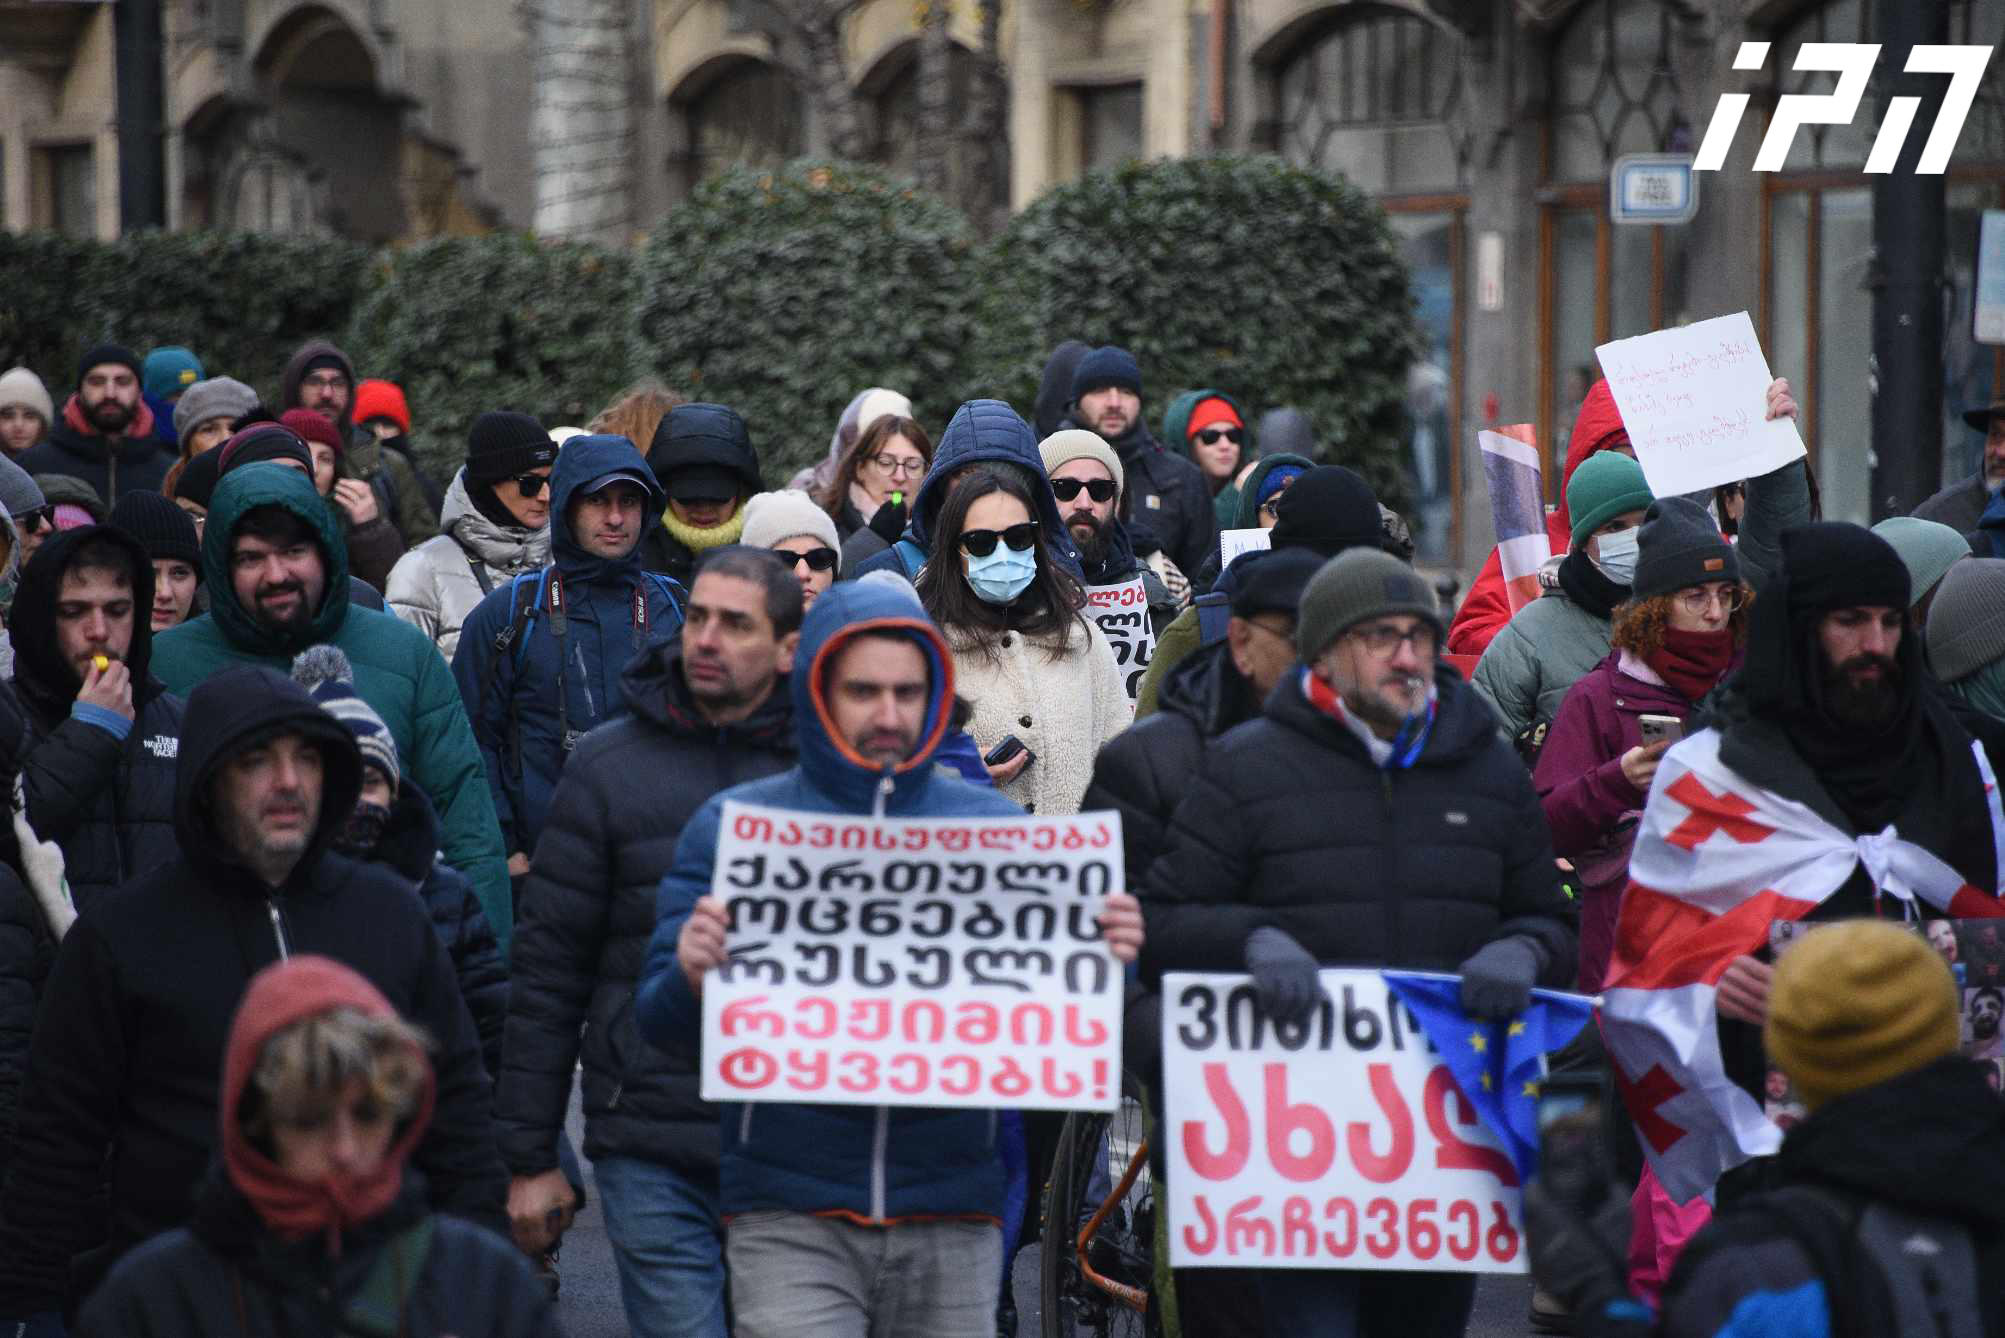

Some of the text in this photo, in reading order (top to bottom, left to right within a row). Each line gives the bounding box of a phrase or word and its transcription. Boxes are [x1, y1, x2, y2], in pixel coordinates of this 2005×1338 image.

[734, 815, 1111, 852] თავისუფლება
[726, 853, 1112, 897] ქართული
[726, 896, 1104, 943] ოცნების
[719, 941, 1109, 994] რუსული
[719, 996, 1109, 1048] რეჟიმის
[718, 1047, 1109, 1099] ტყვეებს!
[1183, 1195, 1520, 1263] არჩევნებ
